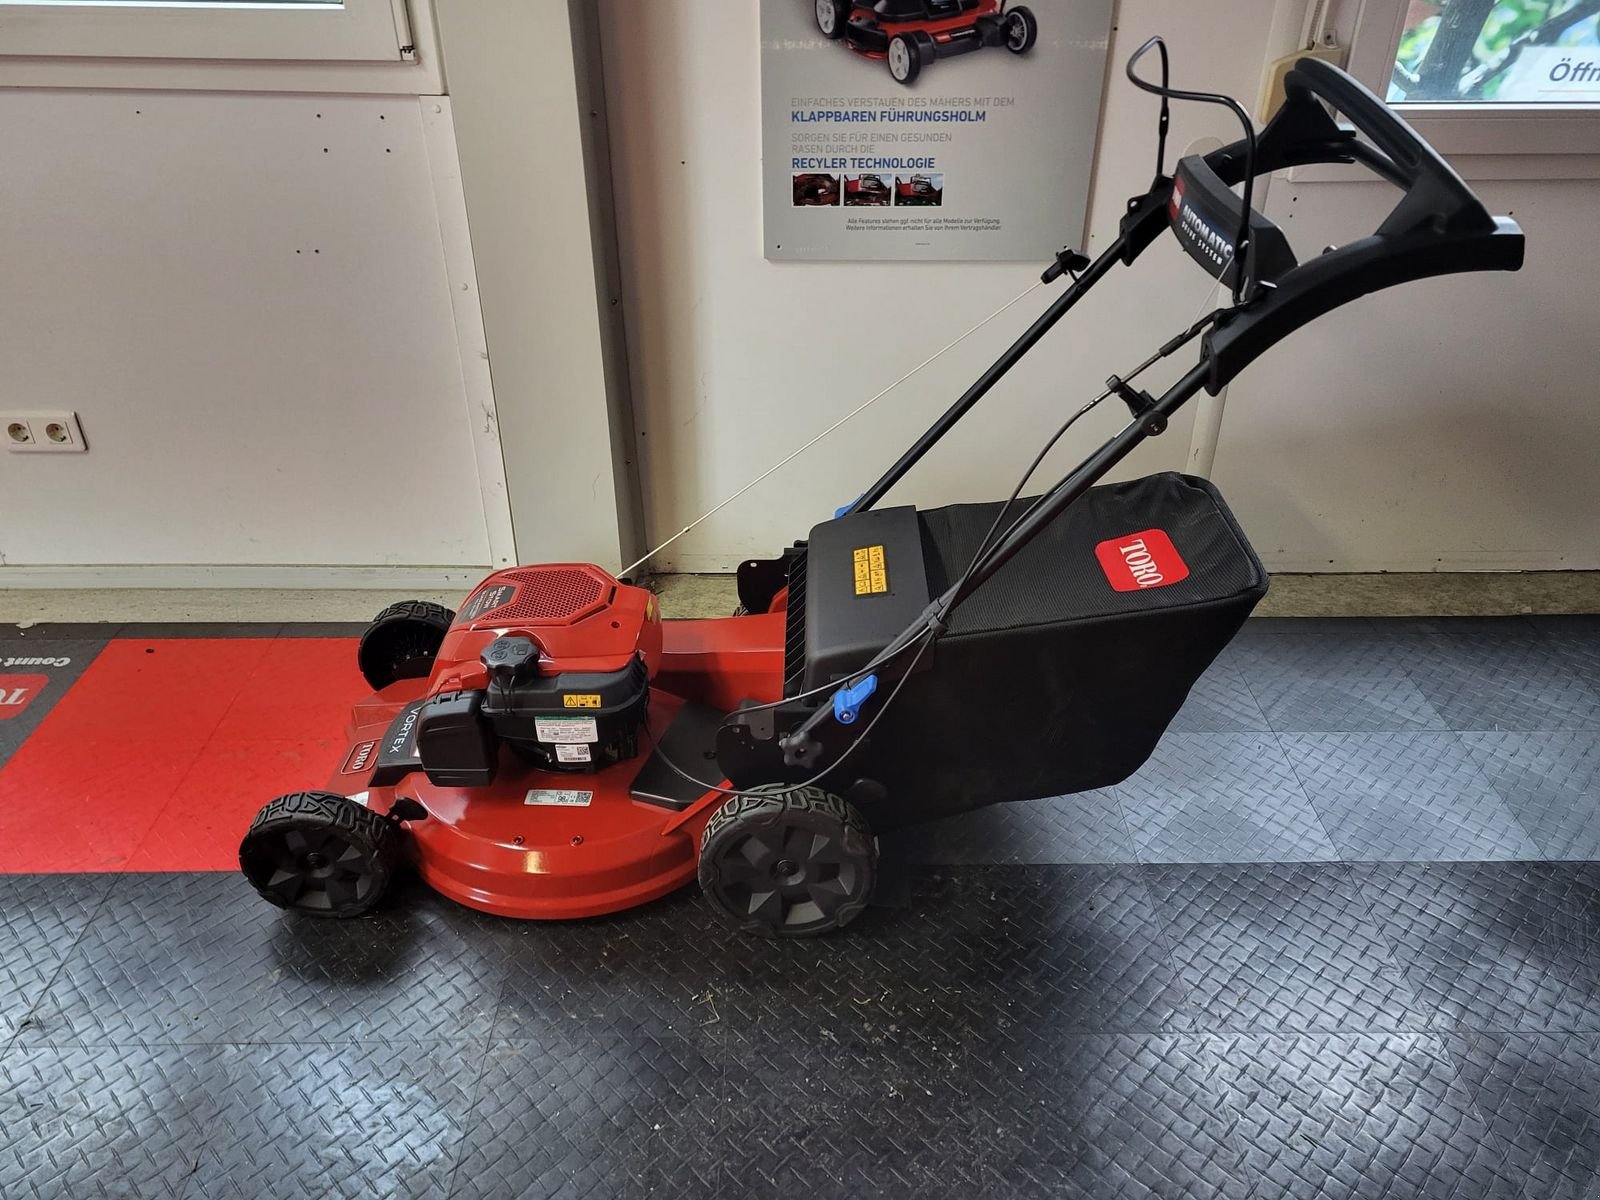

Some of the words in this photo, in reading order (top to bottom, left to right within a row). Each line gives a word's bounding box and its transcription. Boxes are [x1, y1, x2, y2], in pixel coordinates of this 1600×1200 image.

[791, 97, 846, 107] EINFACHES
[847, 97, 905, 107] VERSTAUEN
[907, 97, 927, 107] DES
[973, 97, 992, 107] MIT
[993, 97, 1015, 107] DEM
[791, 110, 877, 122] KLAPPBAREN
[880, 107, 986, 122] FÜHRUNGSHOLM
[791, 132, 830, 142] SORGEN
[832, 132, 847, 142] SIE
[849, 131, 868, 142] FÜR
[870, 132, 899, 142] EINEN
[901, 132, 952, 142] GESUNDEN
[791, 144, 823, 154] RASEN
[826, 144, 858, 154] DURCH
[860, 144, 875, 154] DIE
[792, 157, 847, 169] RECYLER
[850, 157, 936, 169] TECHNOLOGIE
[1183, 204, 1233, 258] AUTOMATIC
[1119, 538, 1163, 588] TORO
[3, 656, 71, 667] Count
[389, 706, 422, 753] VORTEX
[352, 741, 375, 770] TORO
